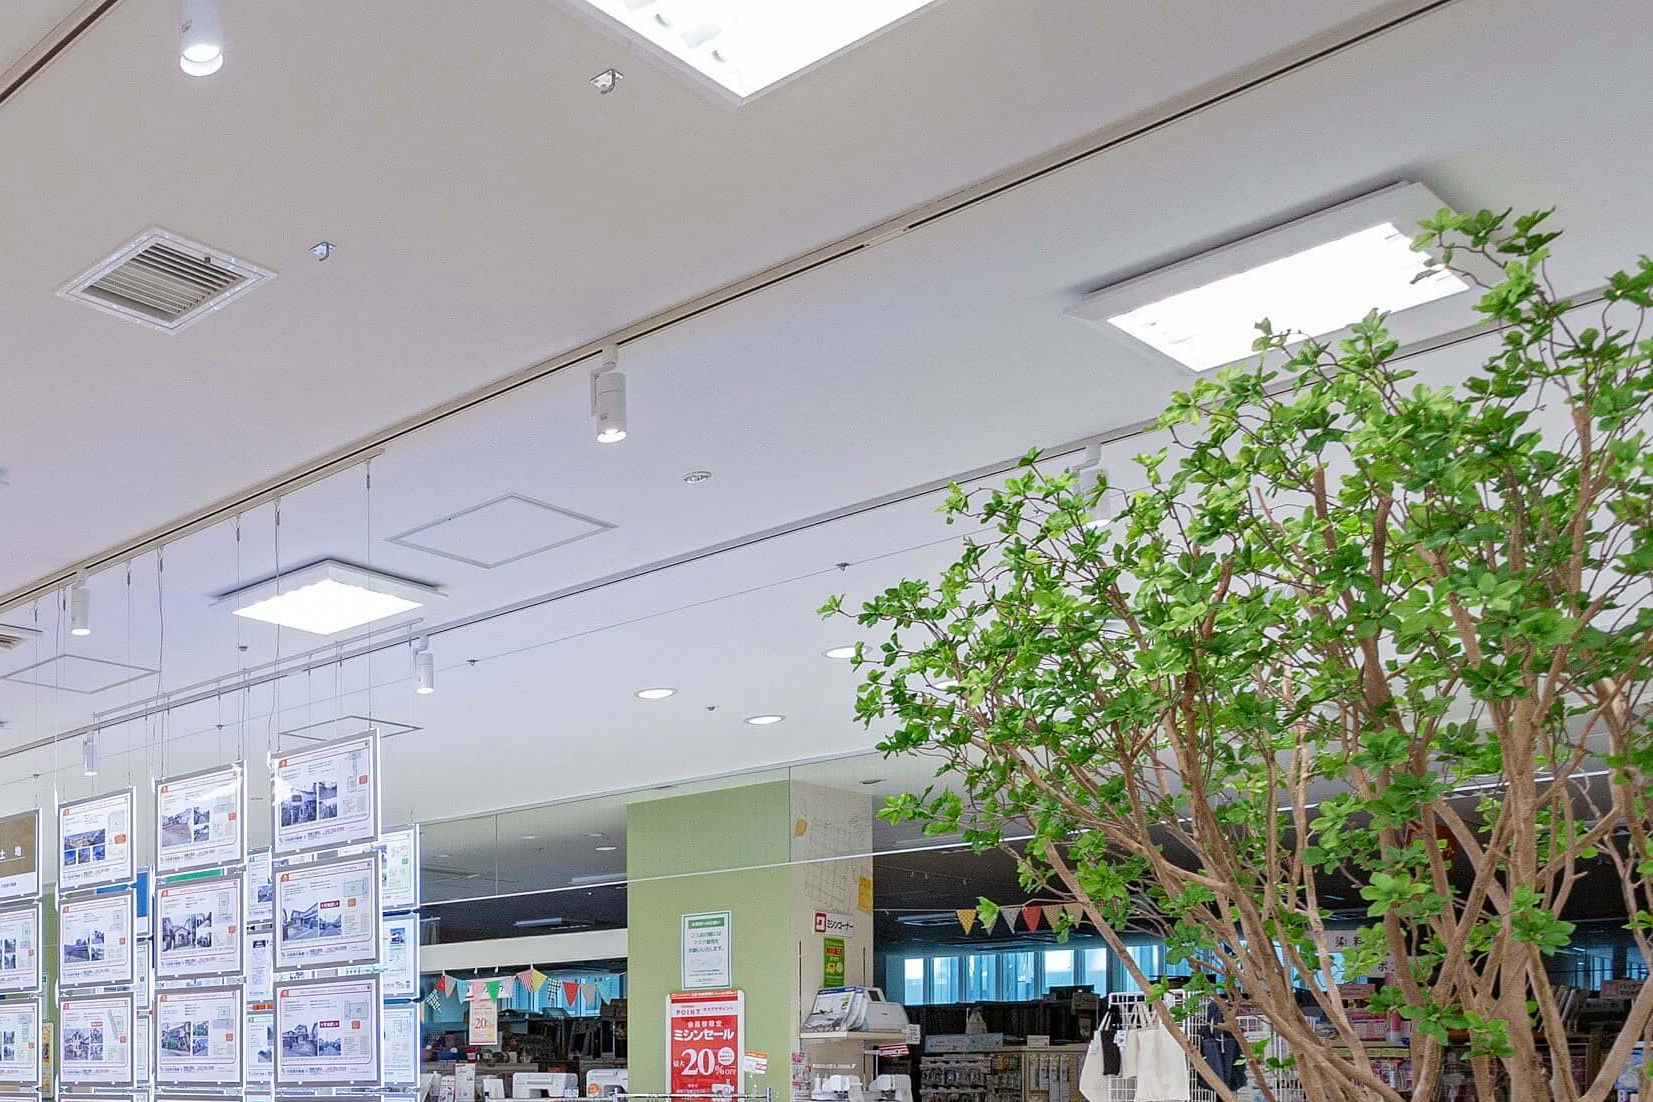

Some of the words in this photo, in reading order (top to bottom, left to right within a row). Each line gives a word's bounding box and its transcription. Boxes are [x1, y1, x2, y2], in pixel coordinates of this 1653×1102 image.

[673, 1028, 735, 1041] ミシンセール
